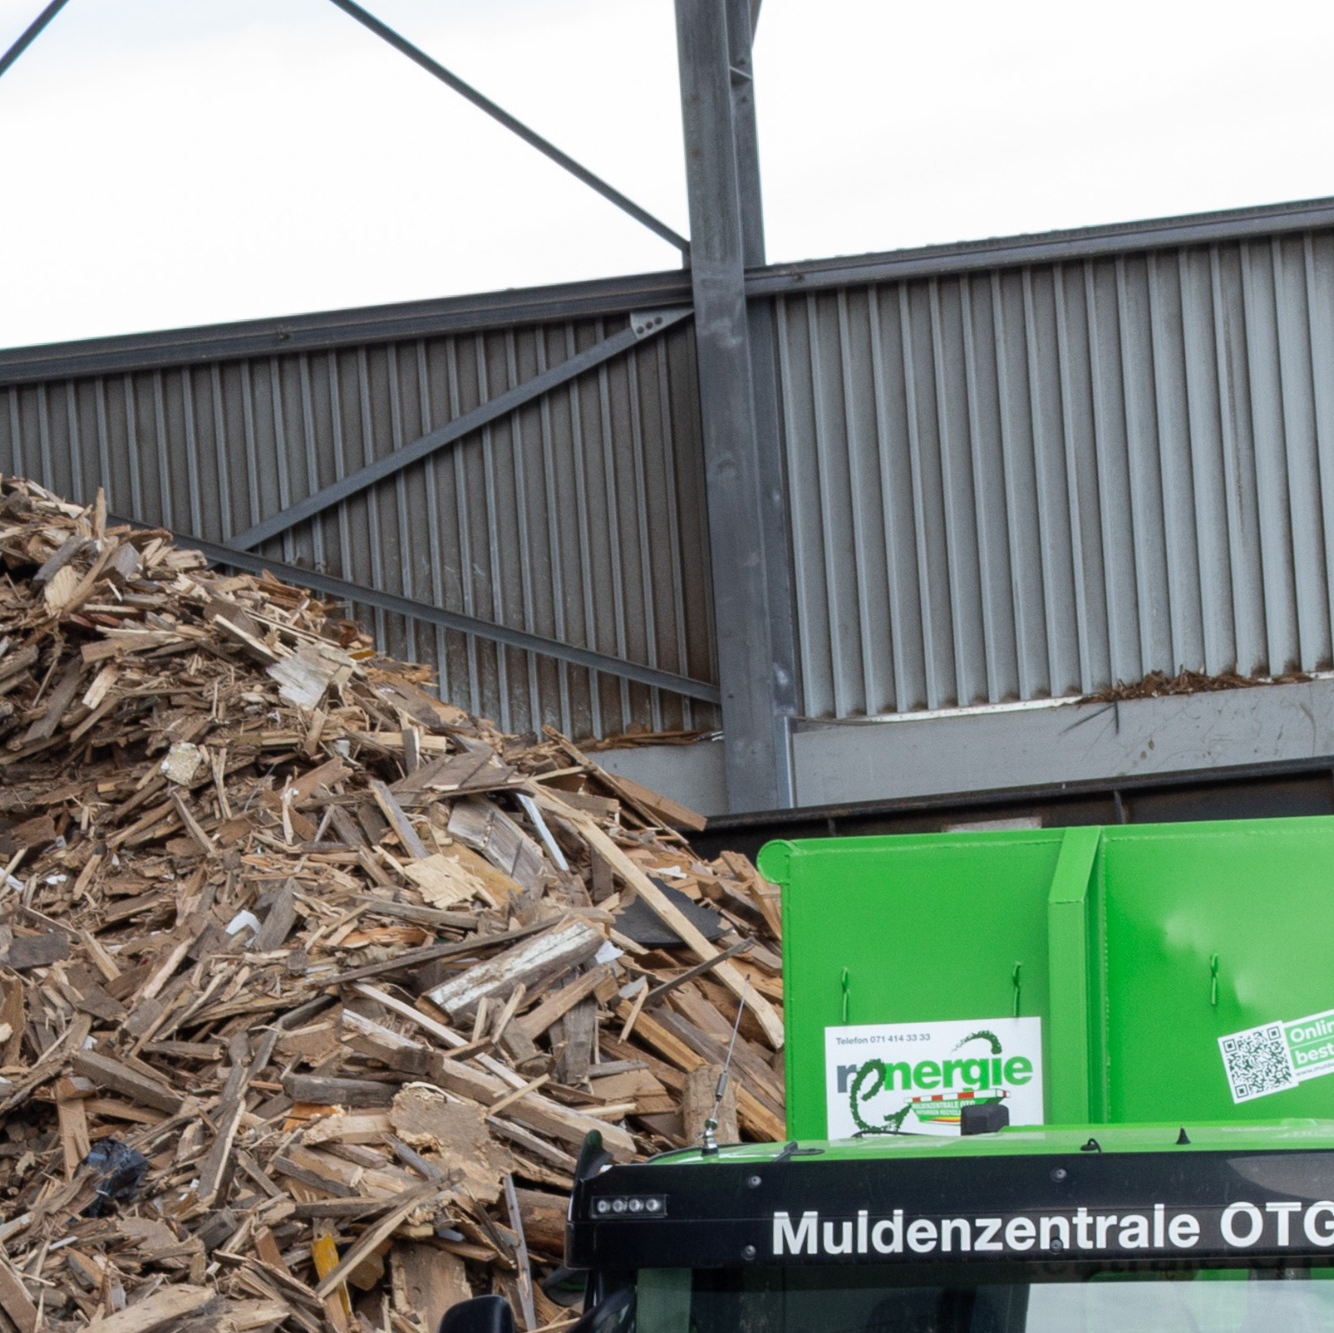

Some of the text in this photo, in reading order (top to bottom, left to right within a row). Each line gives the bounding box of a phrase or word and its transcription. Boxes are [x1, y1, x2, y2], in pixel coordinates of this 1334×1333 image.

[836, 1033, 931, 1046] Telefon 071 414 33 33
[772, 1203, 1201, 1255] Muldenzentrale
